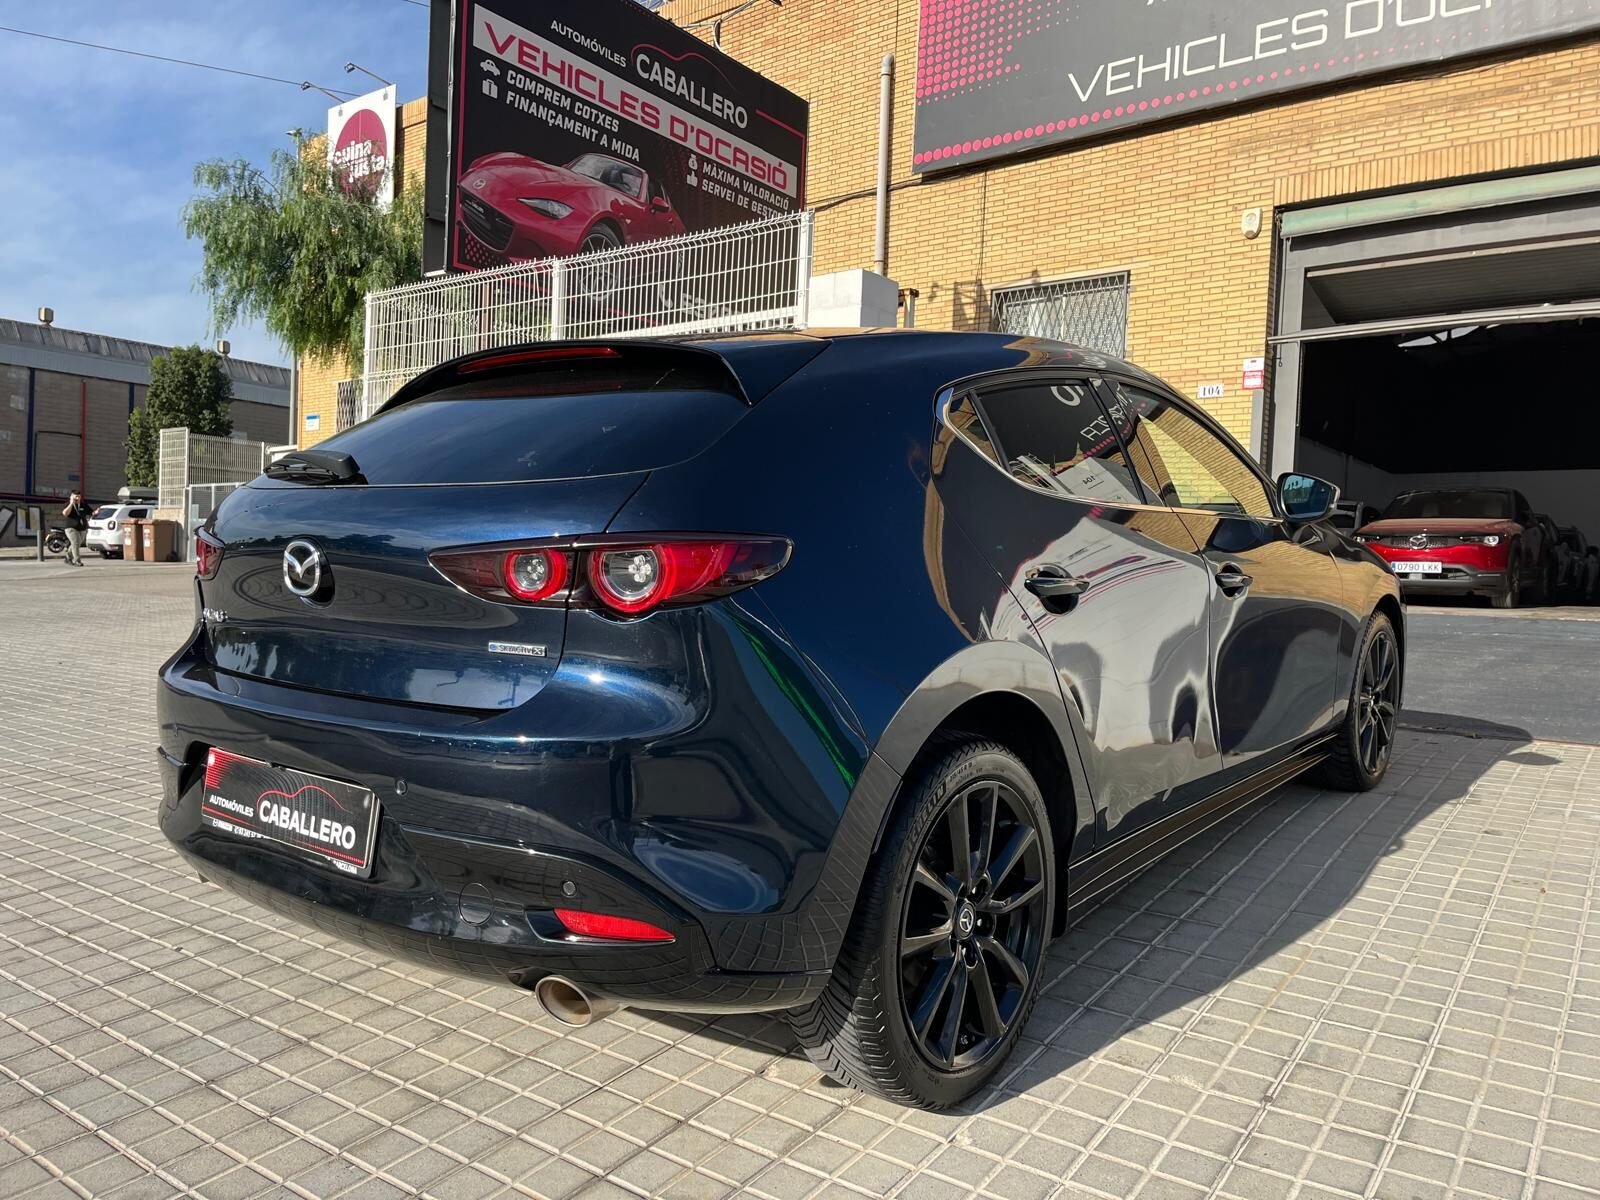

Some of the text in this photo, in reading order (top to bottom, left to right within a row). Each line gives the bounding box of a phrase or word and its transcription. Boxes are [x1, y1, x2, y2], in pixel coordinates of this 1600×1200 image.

[551, 20, 627, 67] AUTOMÓVILES
[1068, 9, 1329, 102] VEHICLES
[484, 21, 787, 190] VEHICLES D'OCASIÓ
[506, 69, 619, 132] COMPREM COTXES
[636, 53, 748, 129] CABALLERO
[506, 91, 640, 162] FINANÇAMENT A MIDA
[701, 179, 735, 203] SERVEI
[737, 194, 749, 209] DE
[703, 161, 789, 210] MÀXIMA VALORACIÓ
[1202, 386, 1220, 396] 104
[1397, 563, 1440, 571] 0790 LKK
[209, 794, 255, 818] AUTOMÓVILES
[259, 800, 357, 850] CABALLERO
